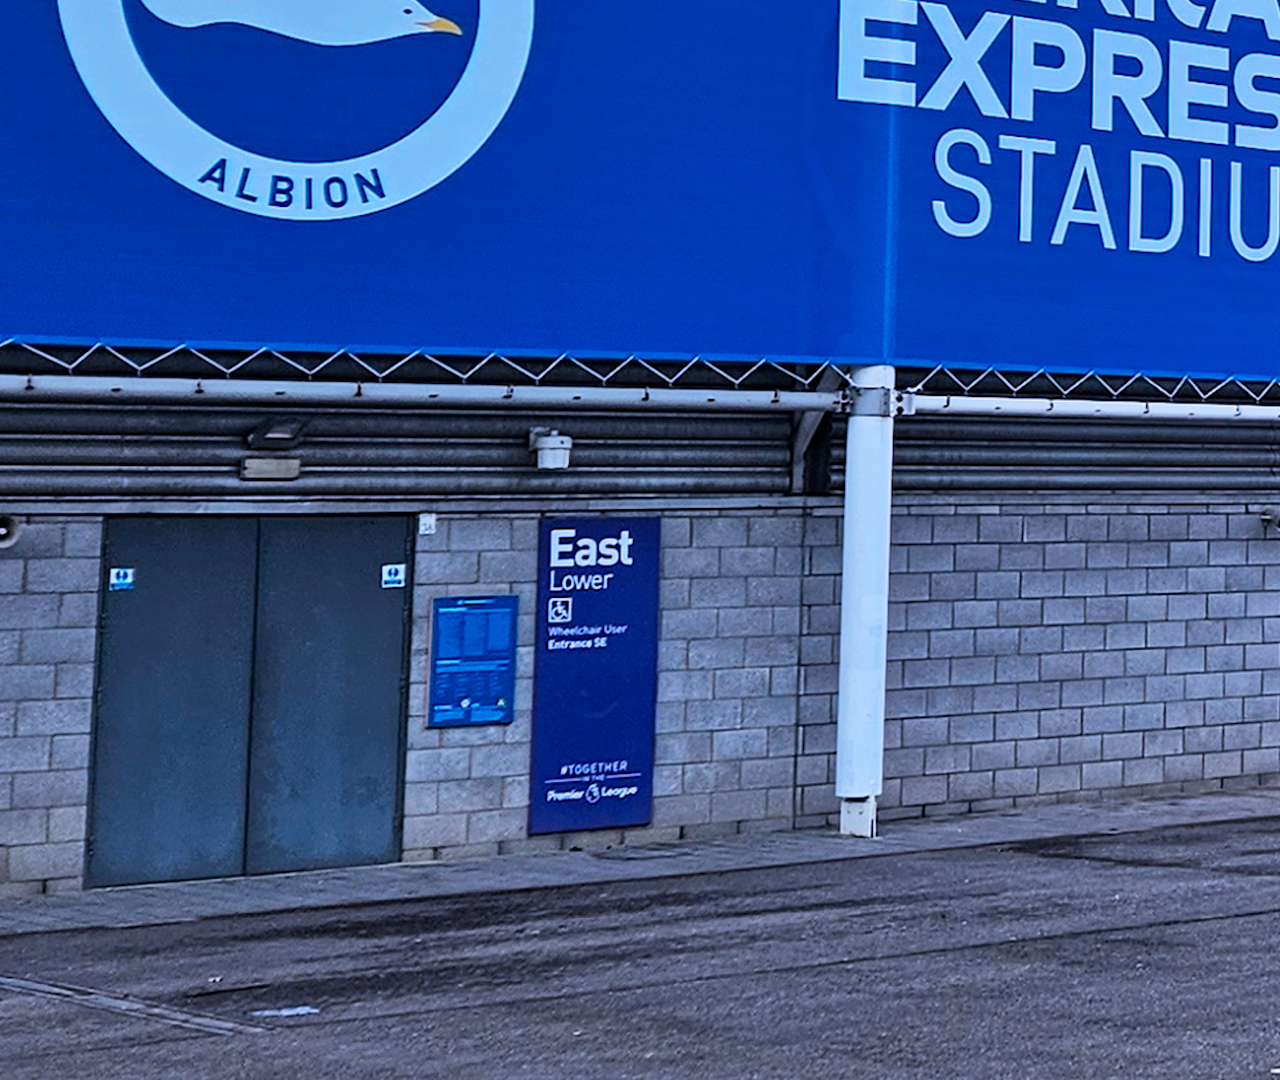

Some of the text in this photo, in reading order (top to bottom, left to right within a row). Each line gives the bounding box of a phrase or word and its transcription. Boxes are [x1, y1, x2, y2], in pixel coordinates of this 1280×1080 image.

[198, 158, 386, 210] ALBION
[549, 528, 634, 568] East
[549, 570, 614, 591] Lower
[548, 624, 628, 637] Wheelchair User
[547, 637, 607, 650] Entrance SE
[547, 786, 638, 802] Premier League
